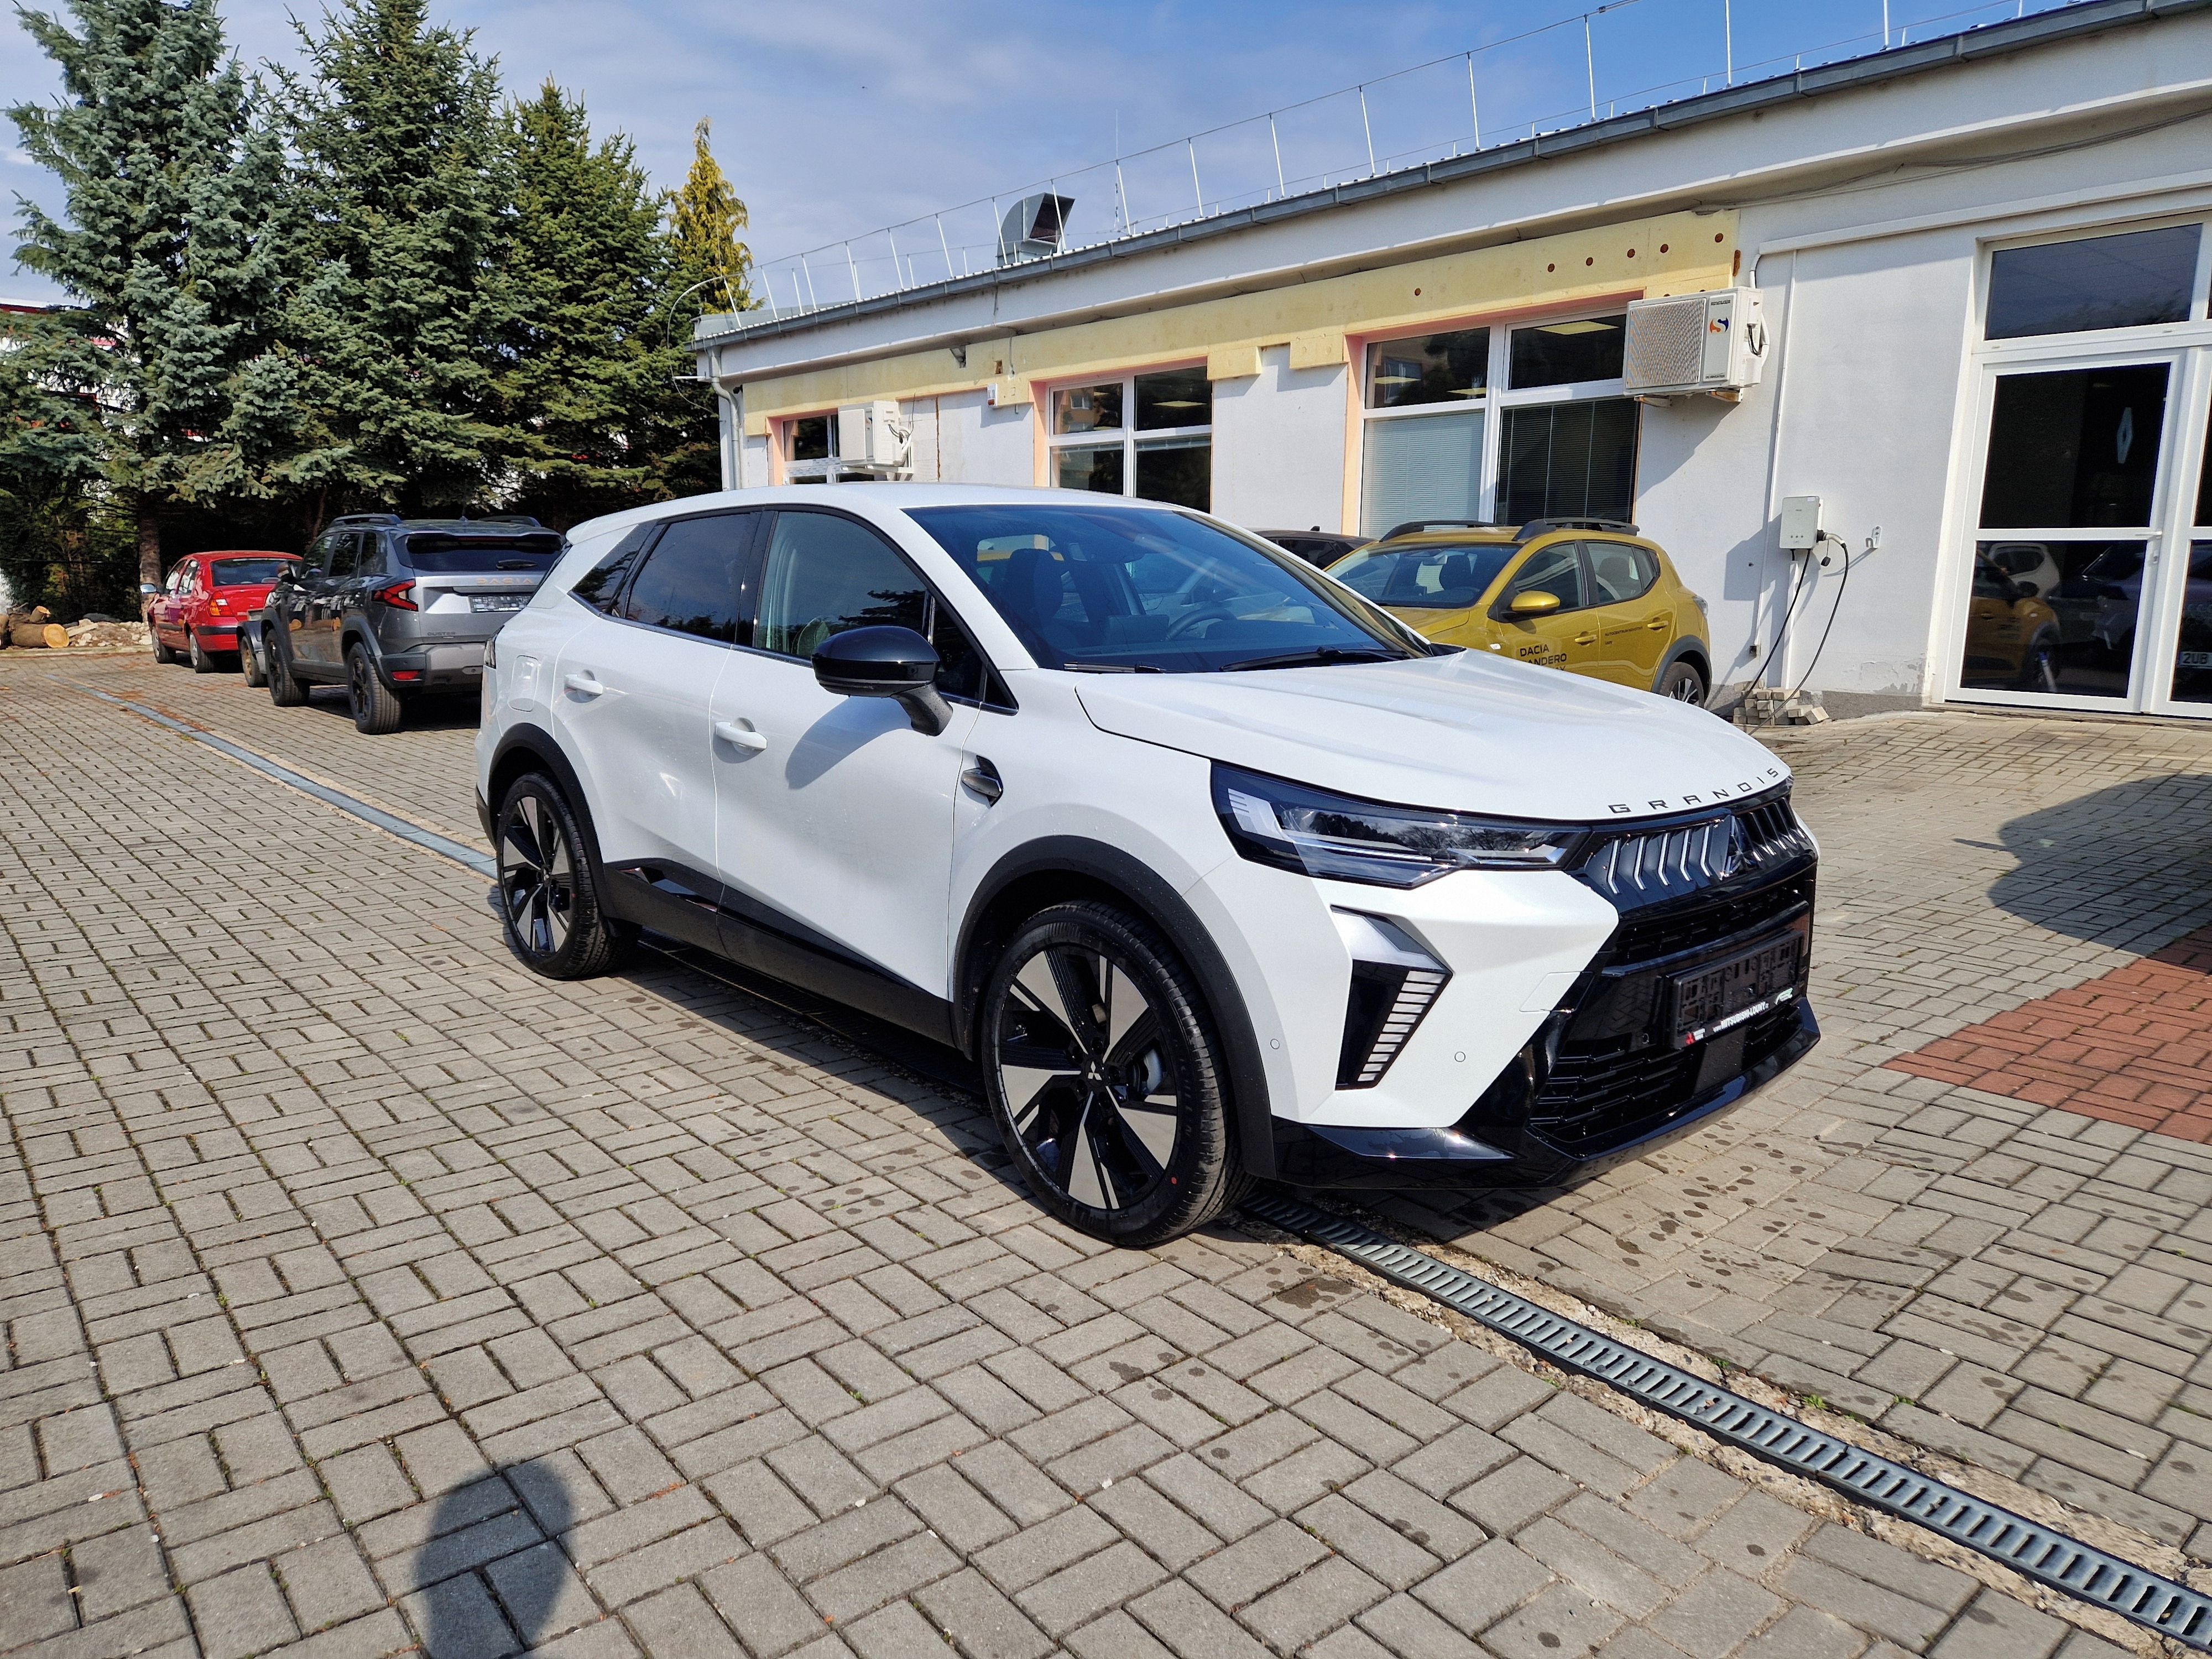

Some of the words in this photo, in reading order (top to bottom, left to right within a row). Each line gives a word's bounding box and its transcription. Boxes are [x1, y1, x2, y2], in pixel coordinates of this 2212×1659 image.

[1520, 644, 1550, 657] DACIA
[1521, 653, 1567, 666] NDERO
[1608, 768, 1779, 814] GRANDIS
